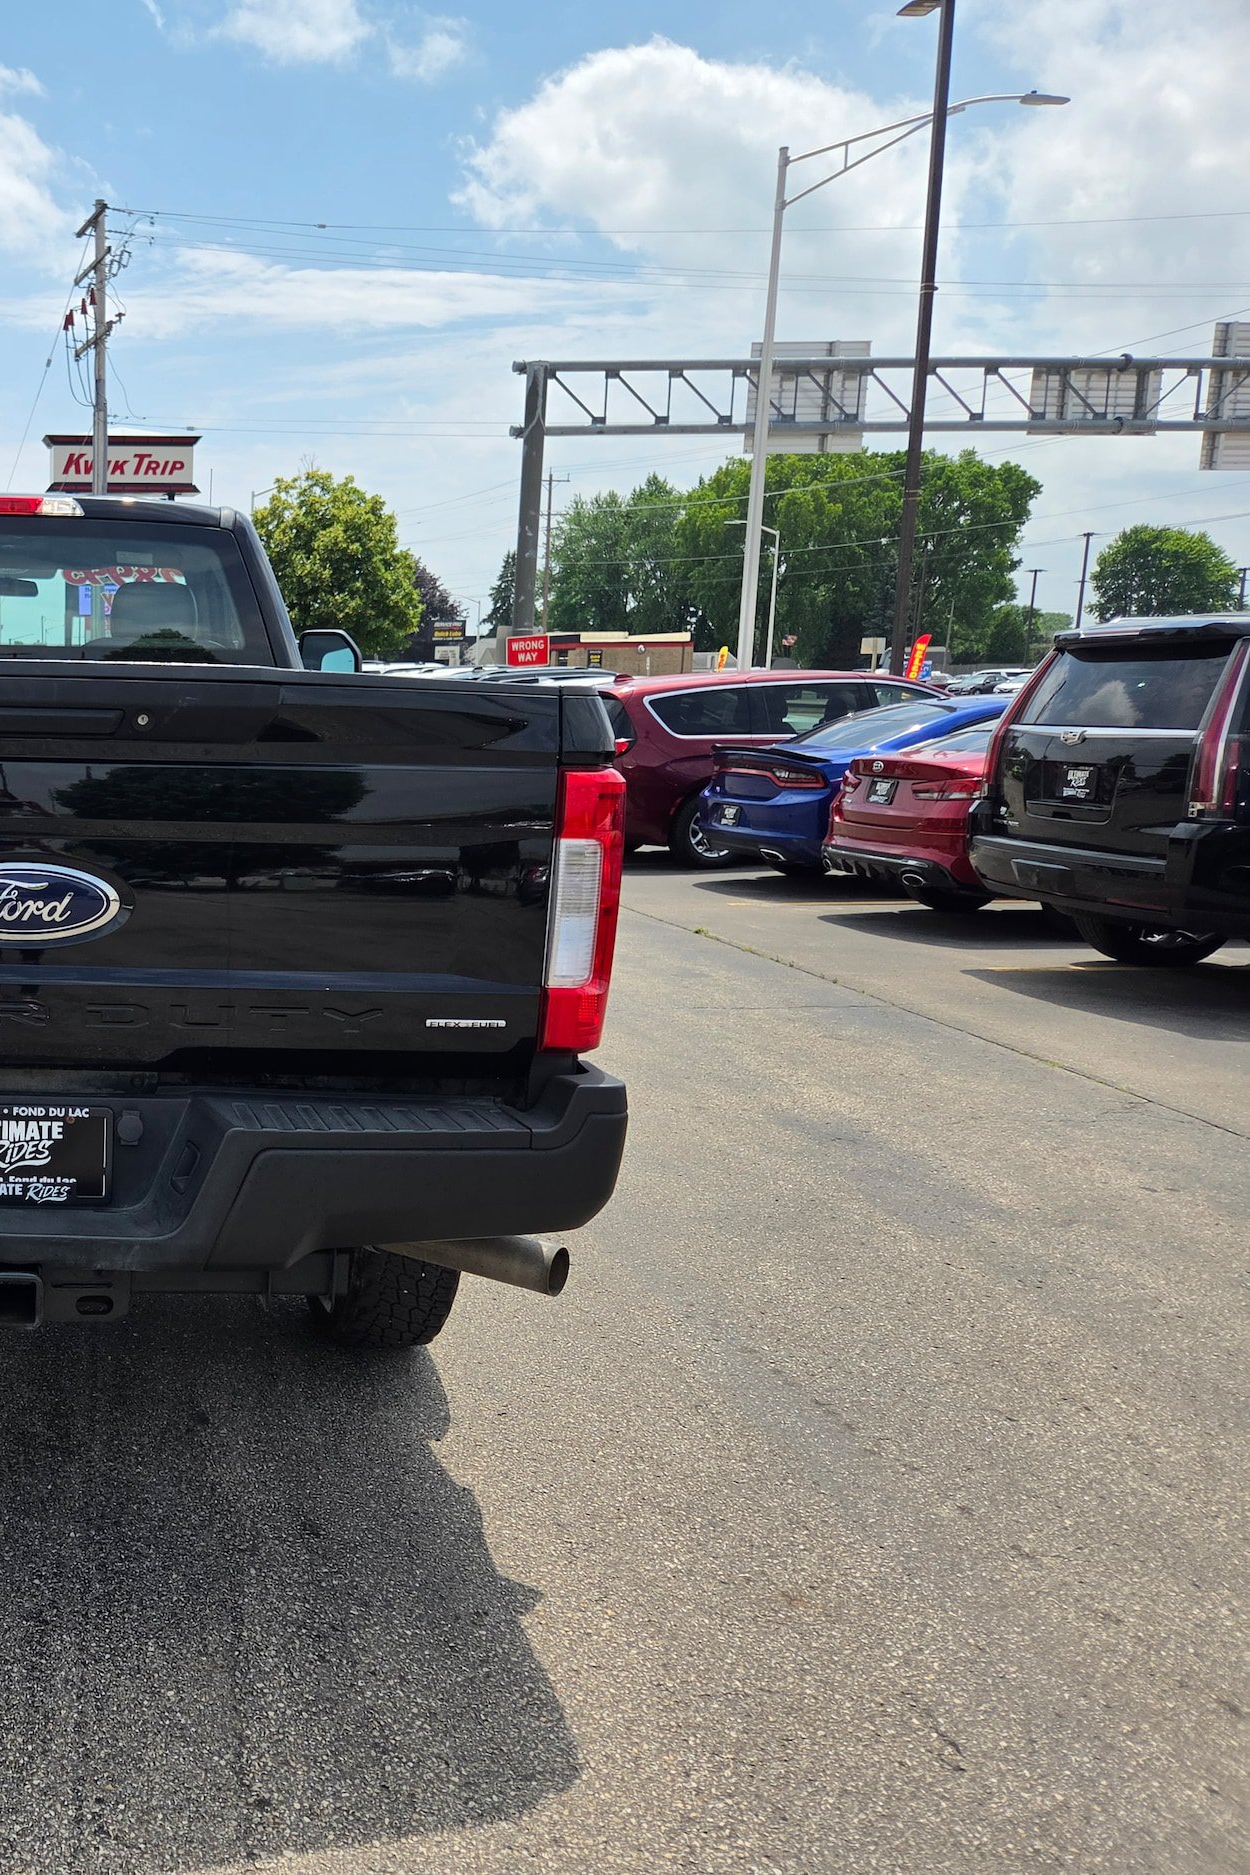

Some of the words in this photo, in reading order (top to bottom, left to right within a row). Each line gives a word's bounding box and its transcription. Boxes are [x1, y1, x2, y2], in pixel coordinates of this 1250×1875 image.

[133, 453, 185, 475] TRIP
[511, 640, 545, 652] WRONG
[518, 651, 538, 663] WAY
[86, 1002, 384, 1033] DUTY
[12, 1106, 46, 1117] FOND
[48, 1107, 66, 1118] DU
[68, 1107, 90, 1118] LAC
[25, 1182, 72, 1204] RIDES
